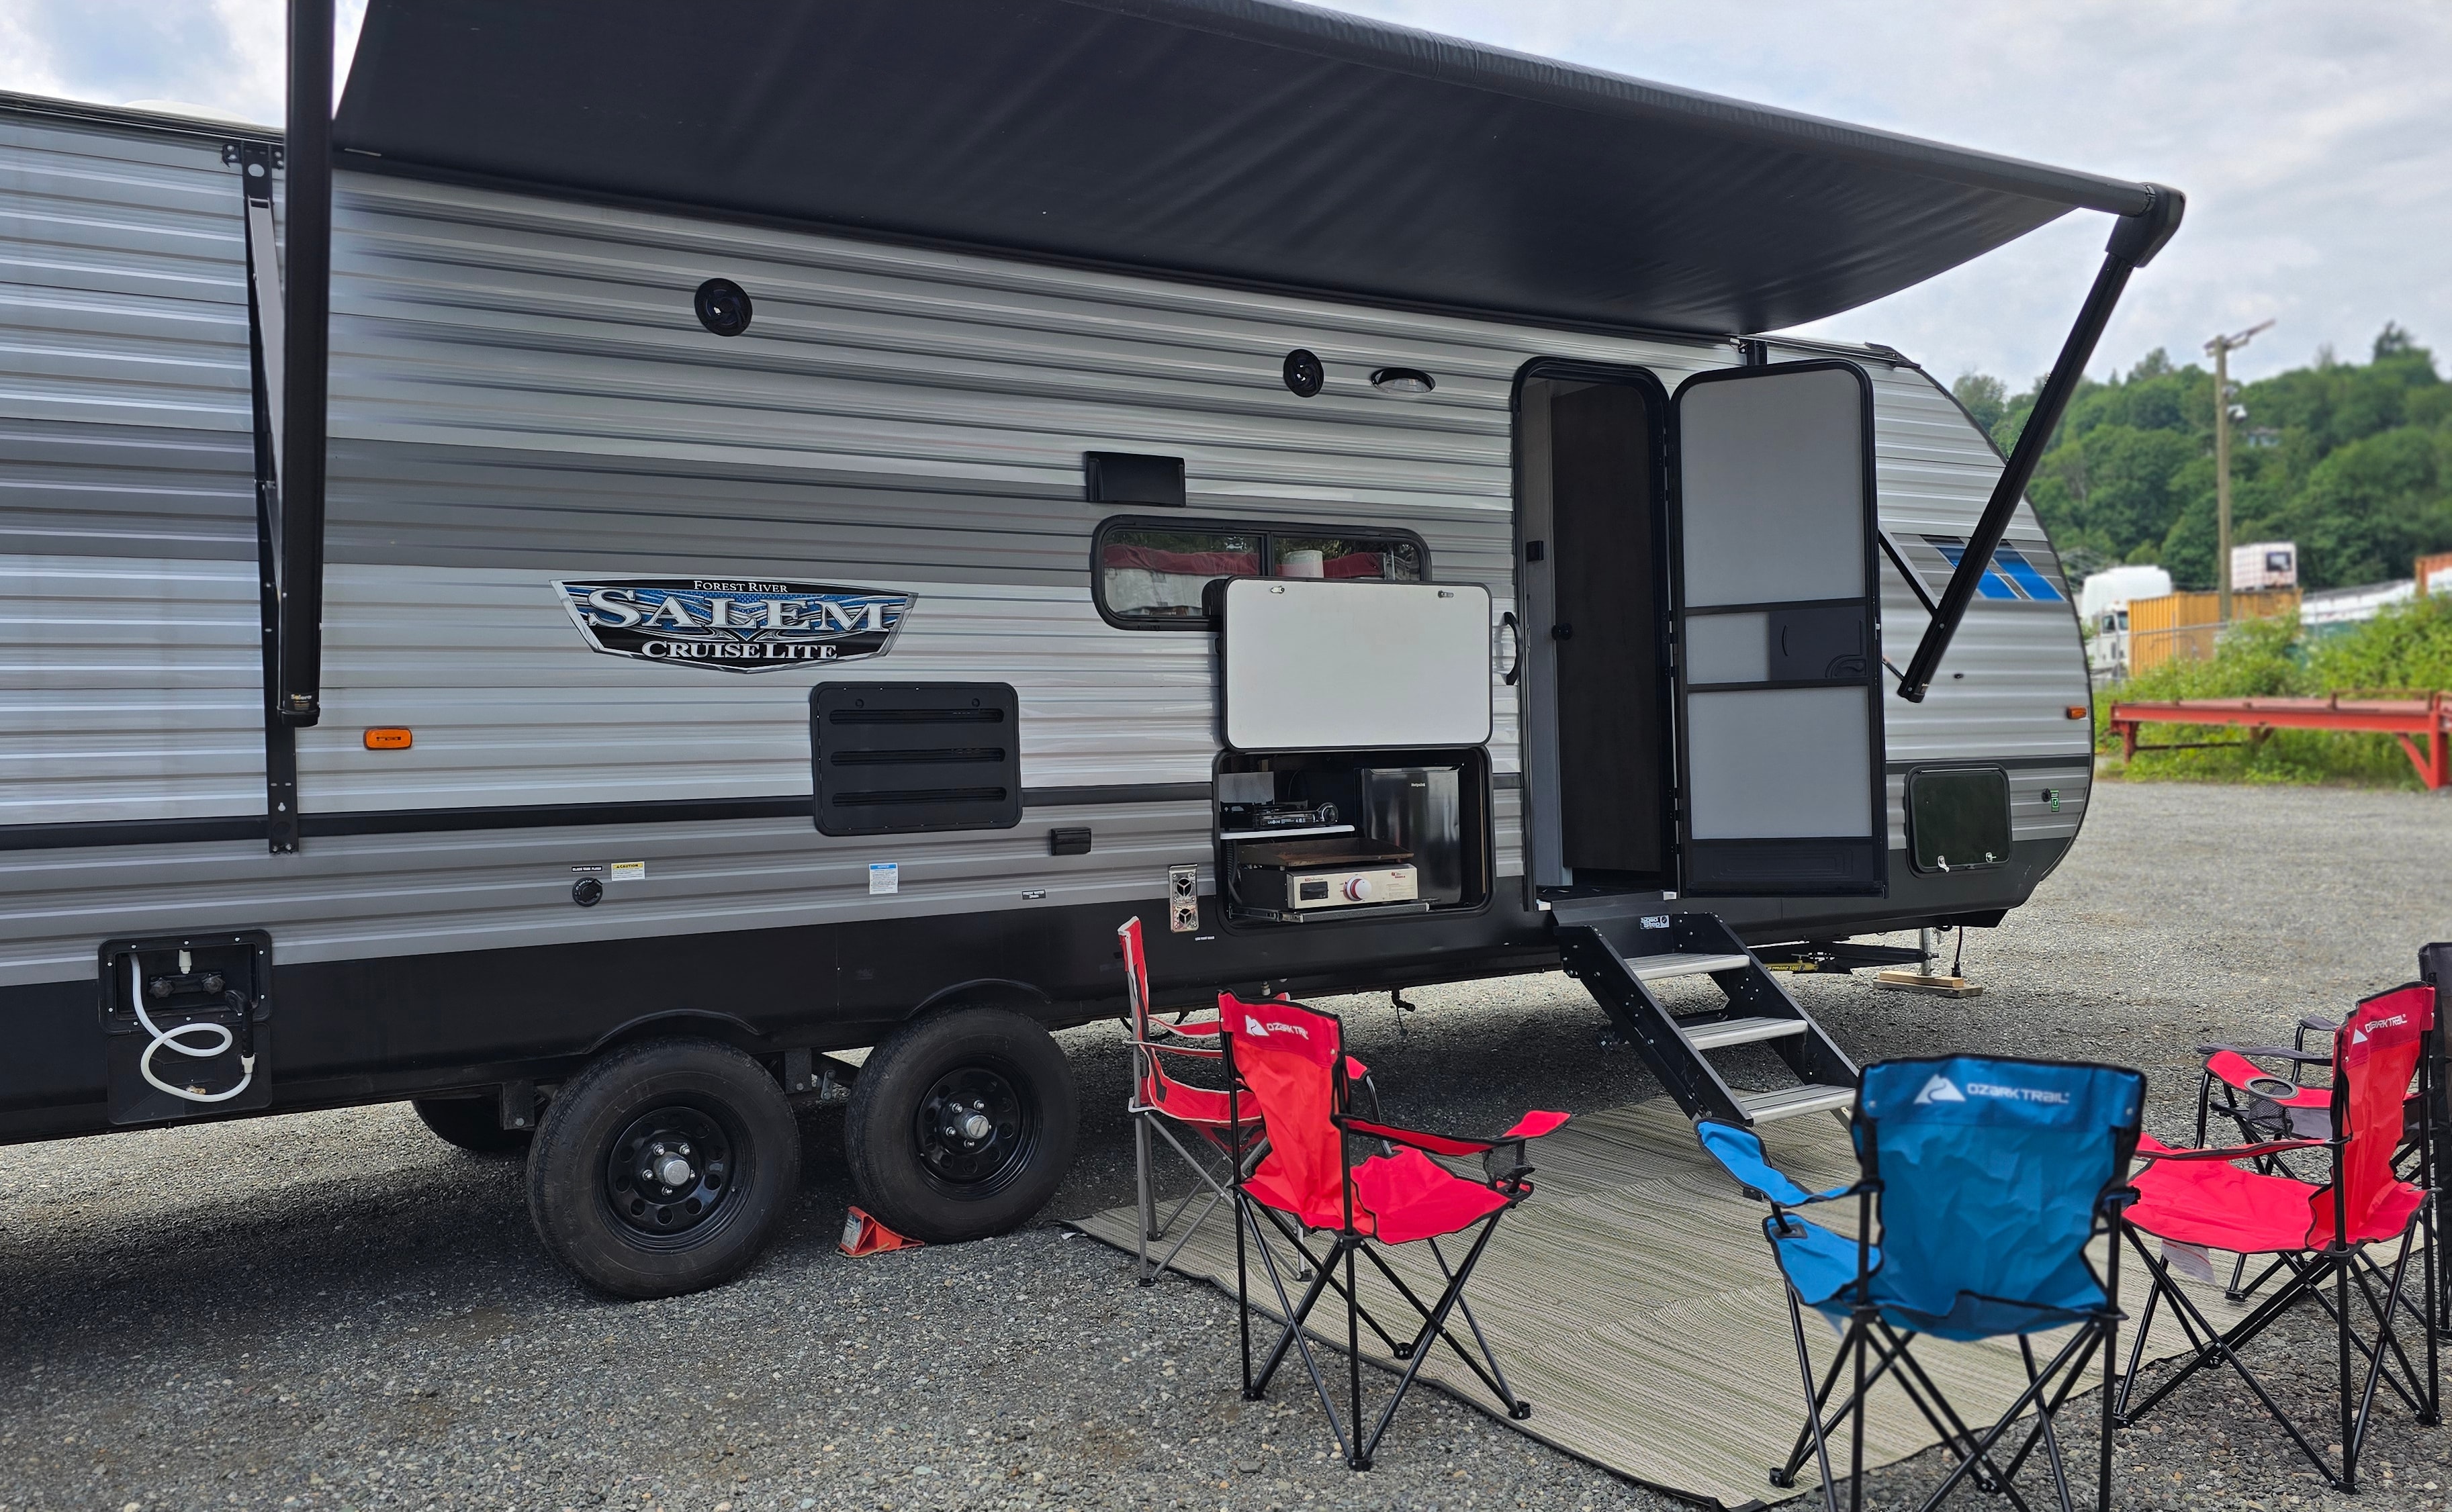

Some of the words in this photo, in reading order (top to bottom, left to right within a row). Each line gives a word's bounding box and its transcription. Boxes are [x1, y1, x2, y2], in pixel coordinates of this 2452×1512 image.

[693, 580, 745, 591] FOREST
[748, 582, 788, 593] RIVER
[588, 588, 892, 633] SALEM
[1266, 1022, 1295, 1034] OZARK
[1966, 1083, 2019, 1099] OZARK
[2021, 1088, 2069, 1104] TRAIL
